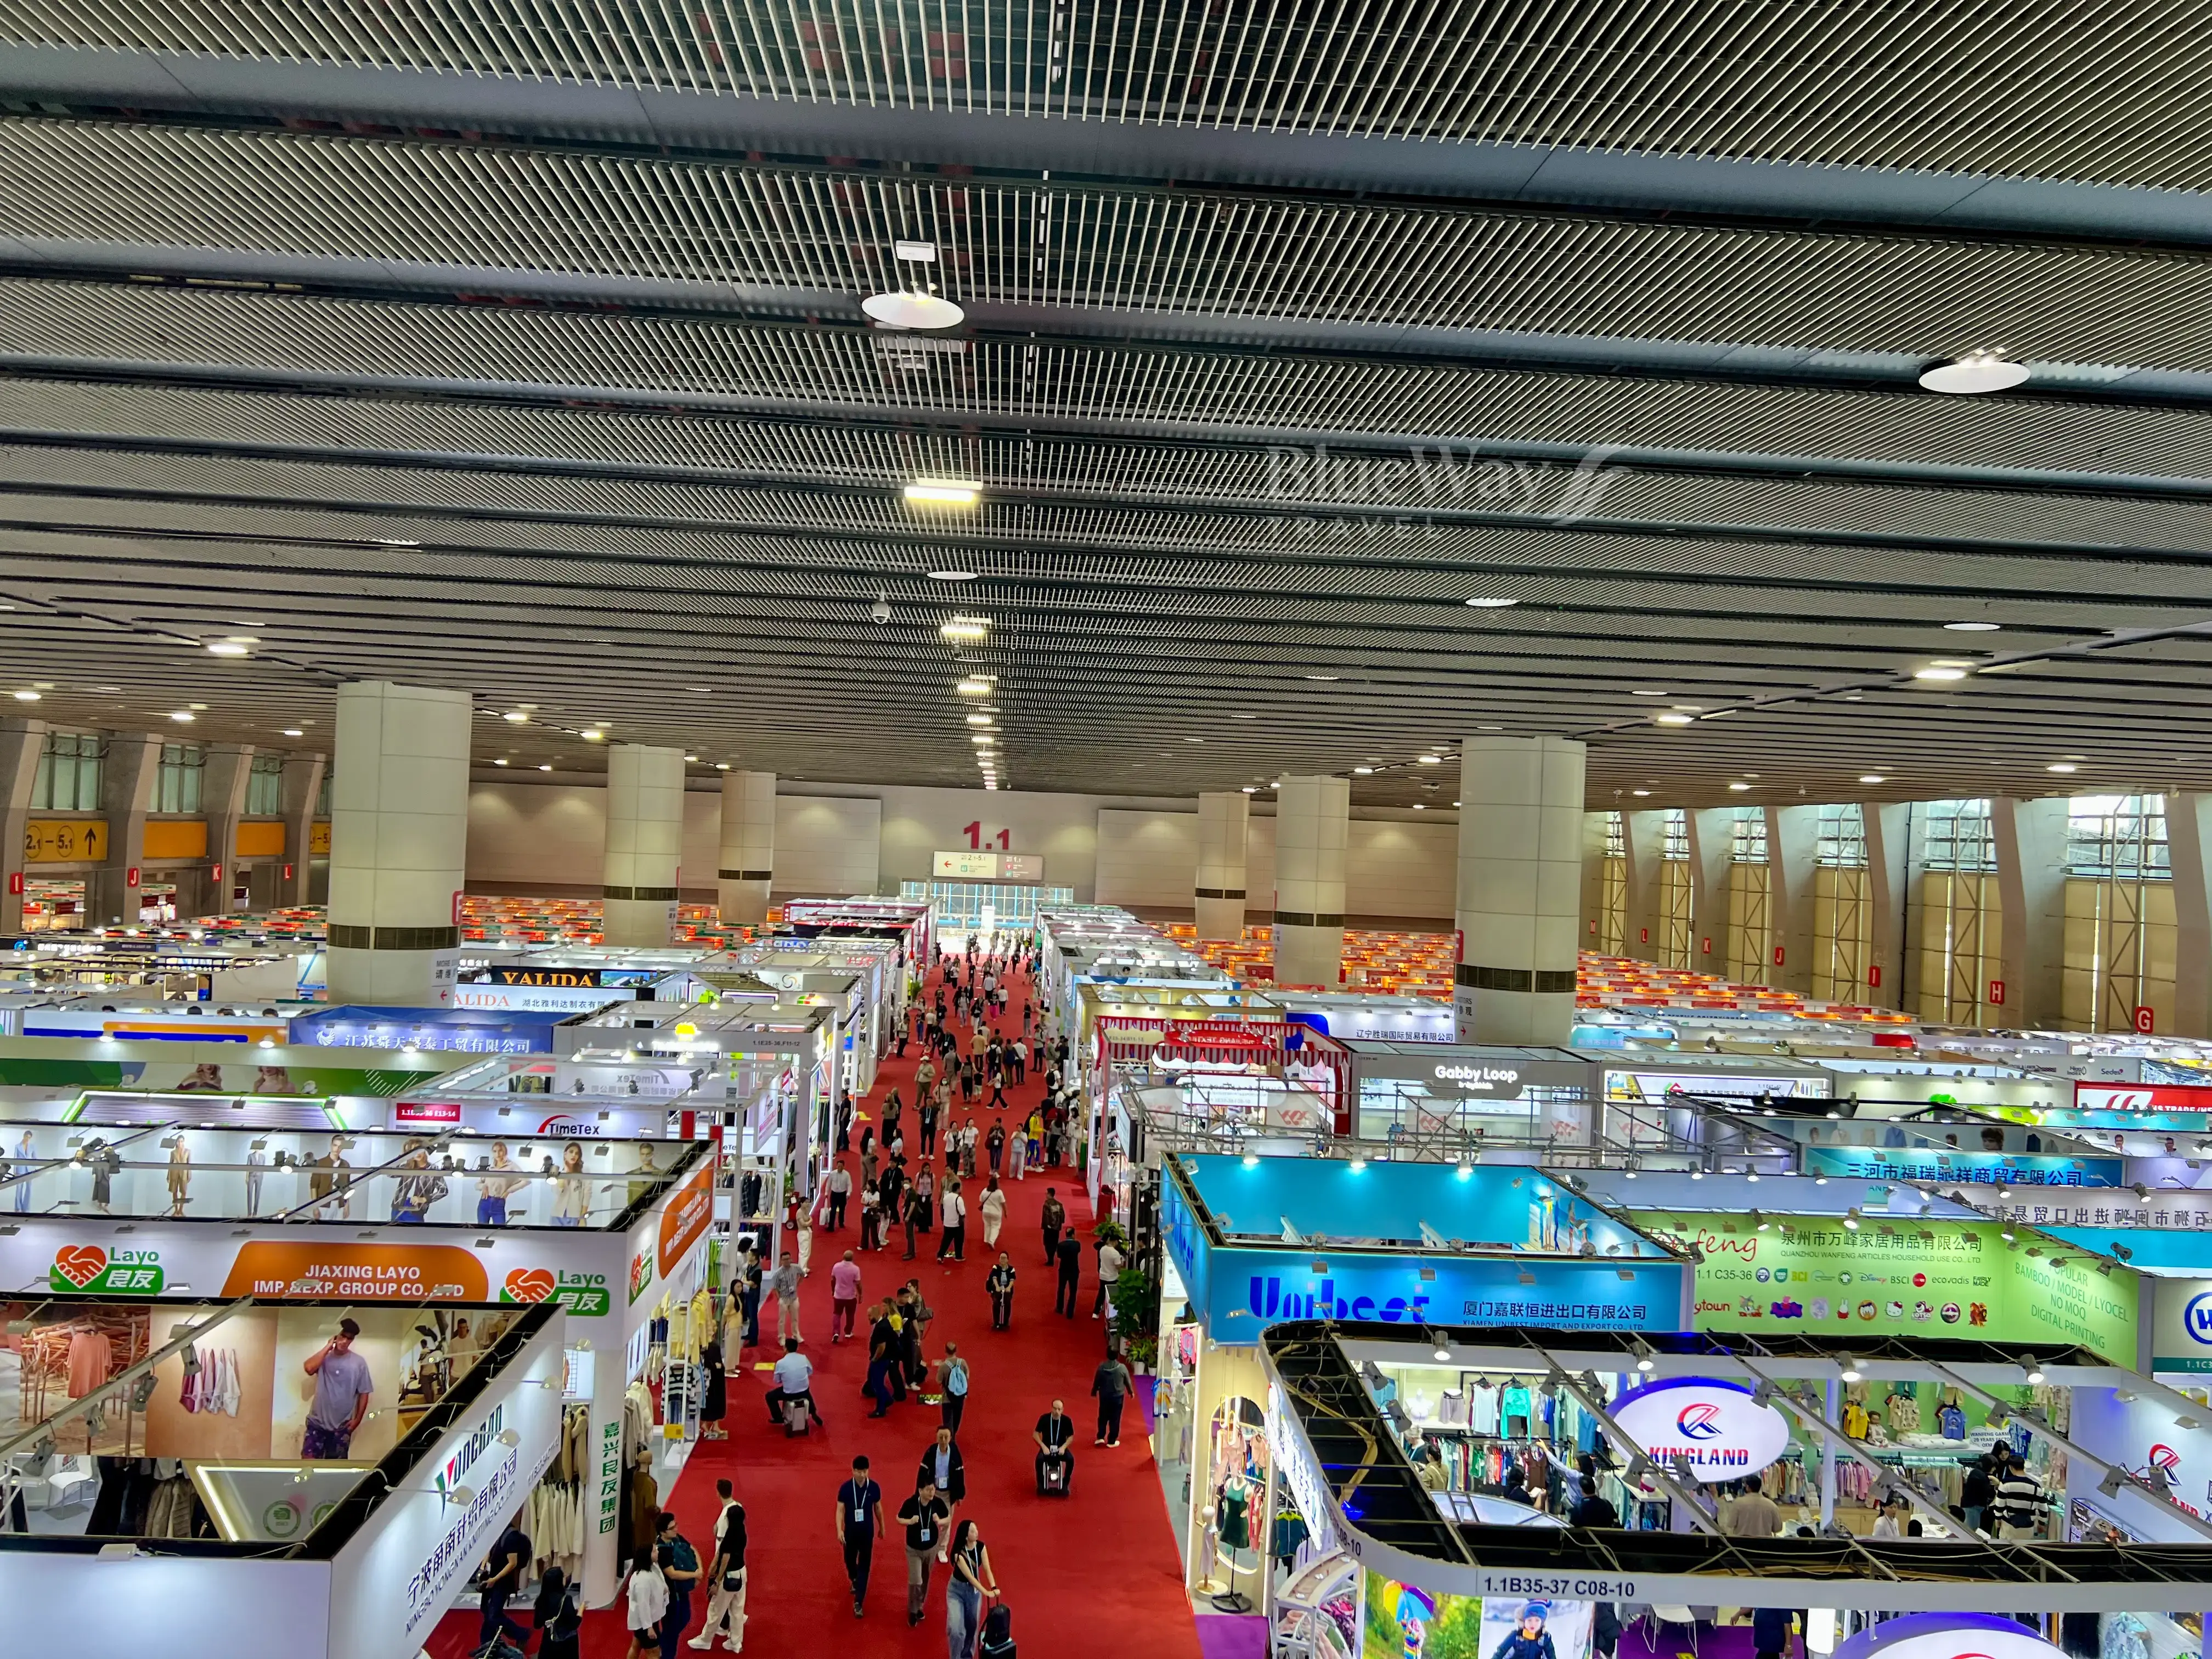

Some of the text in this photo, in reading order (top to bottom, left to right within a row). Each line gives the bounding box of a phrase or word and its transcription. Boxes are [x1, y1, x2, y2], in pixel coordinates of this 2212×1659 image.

[26, 834, 41, 849] 2.1
[58, 834, 73, 849] 5.1
[963, 821, 1009, 850] 1.1
[131, 870, 137, 884] J
[213, 867, 220, 880] K
[285, 867, 290, 879] L
[1704, 940, 1709, 952] K
[1775, 951, 1782, 963] J
[502, 972, 594, 987] YALIDA
[454, 994, 511, 1007] ALIDA
[1993, 985, 2002, 1001] H
[2137, 1011, 2151, 1030] G
[1356, 1029, 1453, 1042] 辽宁胜瑞国际贸易有限公司
[1435, 1065, 1518, 1084] Gabby Loop
[549, 1124, 600, 1136] TimeTex
[1781, 1230, 1982, 1252] 泉州市万峰家居用品有限公司
[110, 1247, 159, 1265] Layo
[1857, 1252, 1891, 1261] ARTICLES
[1892, 1254, 1934, 1262] HOUSEHOLD
[105, 1269, 156, 1289] 良友
[305, 1265, 421, 1279] JIAXING LAYO
[558, 1270, 606, 1287] Layo
[1696, 1269, 1752, 1280] 1.1 C35-36
[1791, 1271, 1808, 1282] BCI
[1890, 1276, 1909, 1284] BSCI
[1931, 1276, 1970, 1285] ecovadis
[2049, 1265, 2089, 1287] OPULAR
[557, 1291, 602, 1311] 良友
[2015, 1262, 2050, 1287] BAMBOO
[2057, 1280, 2087, 1305] MODEL
[2095, 1296, 2129, 1323] LYOCEL
[1463, 1300, 1646, 1320] 厦门嘉联恒进出口有限公司
[2051, 1293, 2086, 1322] NO MOQ
[2031, 1304, 2106, 1349] DIGITAL PRINTING
[1649, 1447, 1748, 1466] KINGLAND
[599, 1421, 620, 1534] 嘉兴良友集团
[407, 1447, 517, 1609] 宁波甬南针织有限公司
[405, 1589, 435, 1638] NINGBO
[435, 1547, 467, 1596] YONGNAN
[1484, 1576, 1635, 1598] 1.1B35-37 C08-10
